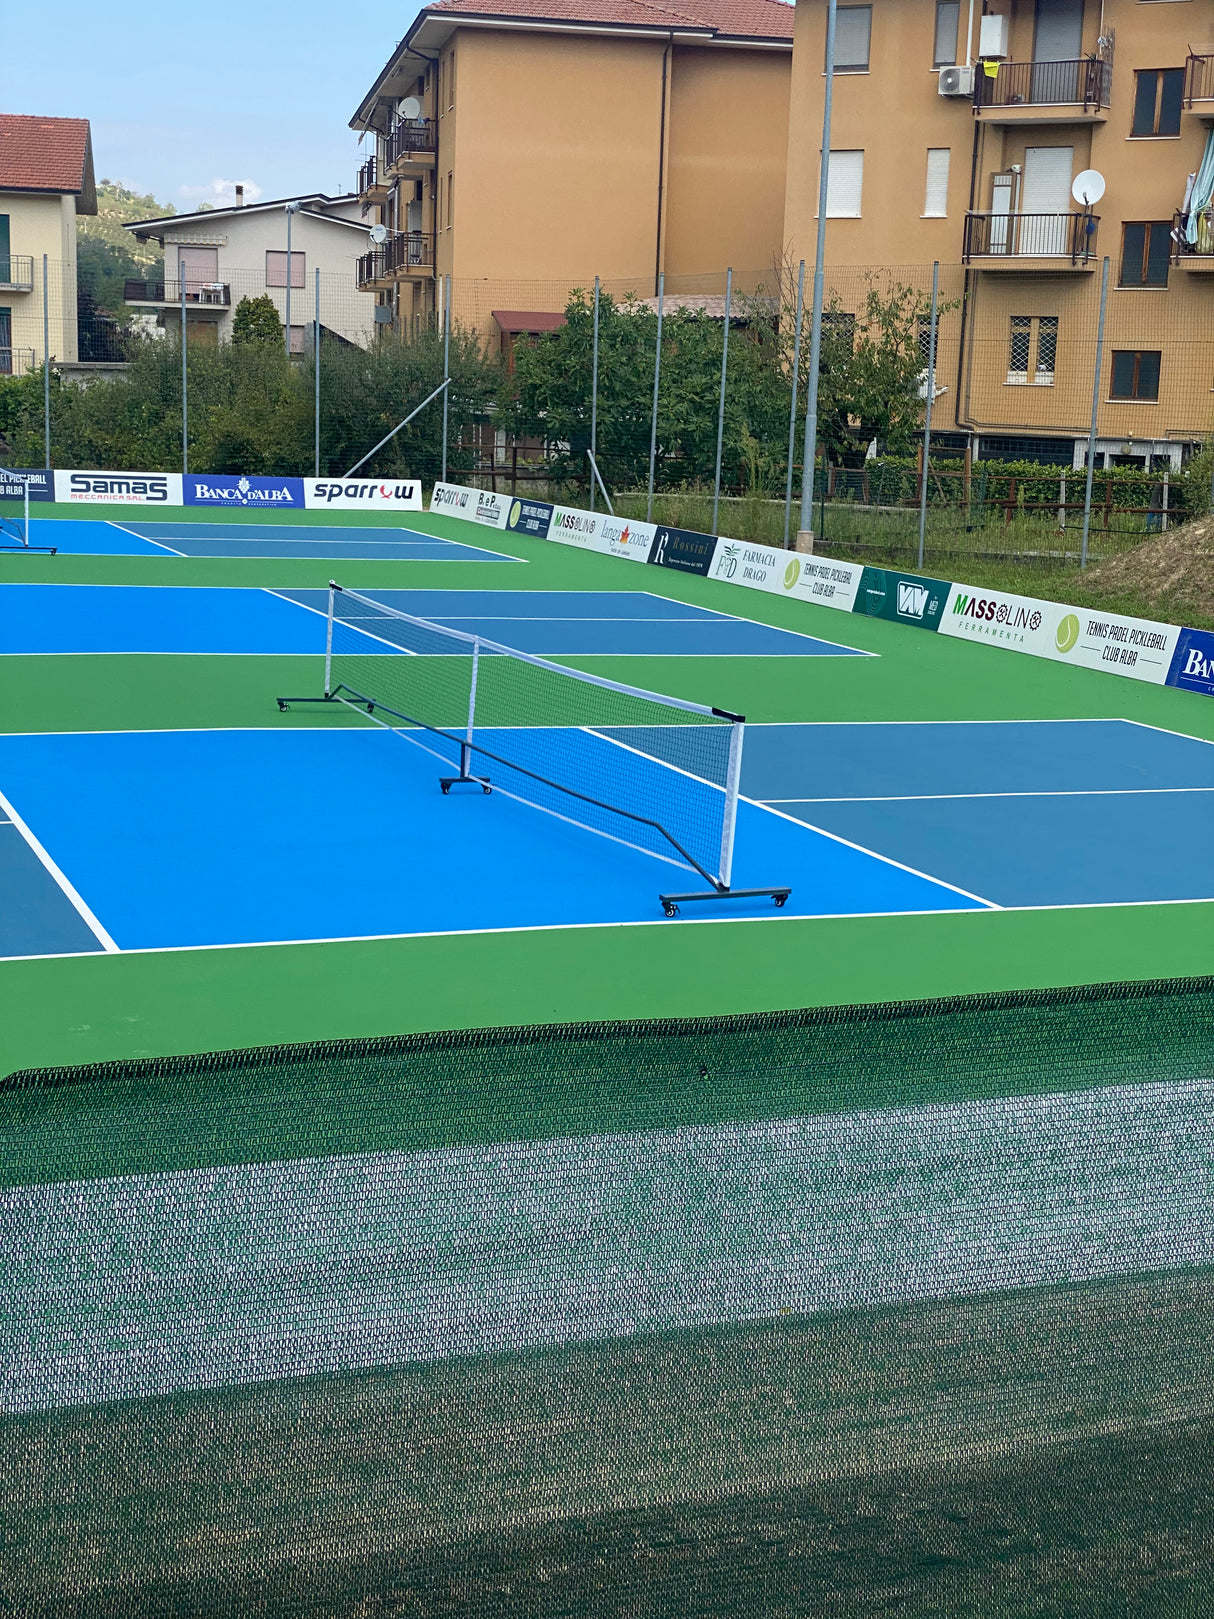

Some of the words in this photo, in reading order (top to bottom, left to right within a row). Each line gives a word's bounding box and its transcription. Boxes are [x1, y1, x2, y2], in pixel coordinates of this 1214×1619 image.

[6, 485, 23, 495] ALBA
[194, 483, 242, 499] BANCA
[672, 536, 709, 555] Rossini
[742, 549, 776, 567] FARMACIA
[742, 566, 767, 582] DRAGO
[803, 563, 819, 577] TENNIS
[952, 594, 1042, 631] MASSOLINO
[958, 621, 1025, 643] FERRAMENTA
[1086, 620, 1110, 639] TENNIS
[1108, 625, 1129, 643] PADEL
[1128, 629, 1168, 651] PICKLEBALL
[1102, 645, 1121, 662] CLUB
[1118, 650, 1139, 667] ALBA
